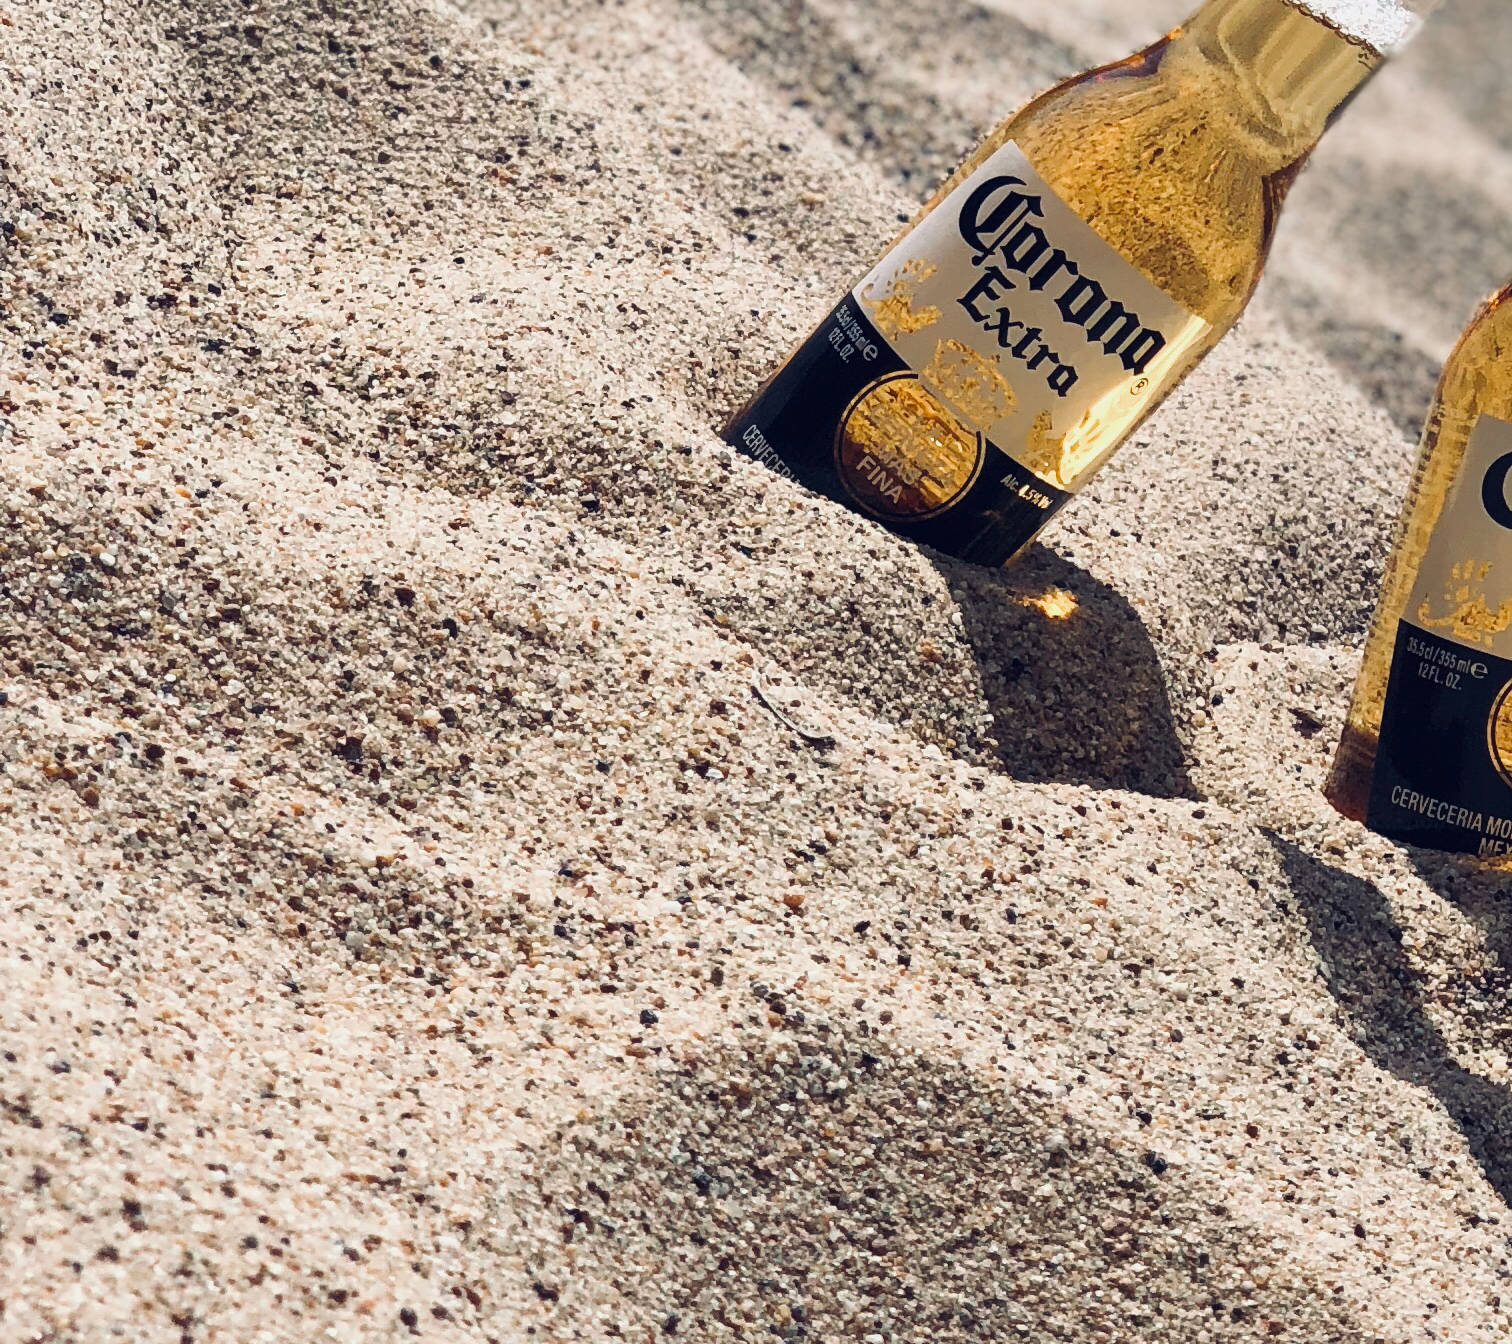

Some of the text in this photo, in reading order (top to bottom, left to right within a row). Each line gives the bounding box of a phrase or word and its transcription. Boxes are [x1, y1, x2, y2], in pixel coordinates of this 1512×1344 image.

[959, 175, 1166, 375] Corona
[956, 266, 1079, 397] Extra
[856, 455, 903, 504] FINA
[1391, 785, 1482, 832] CERVECERIA
